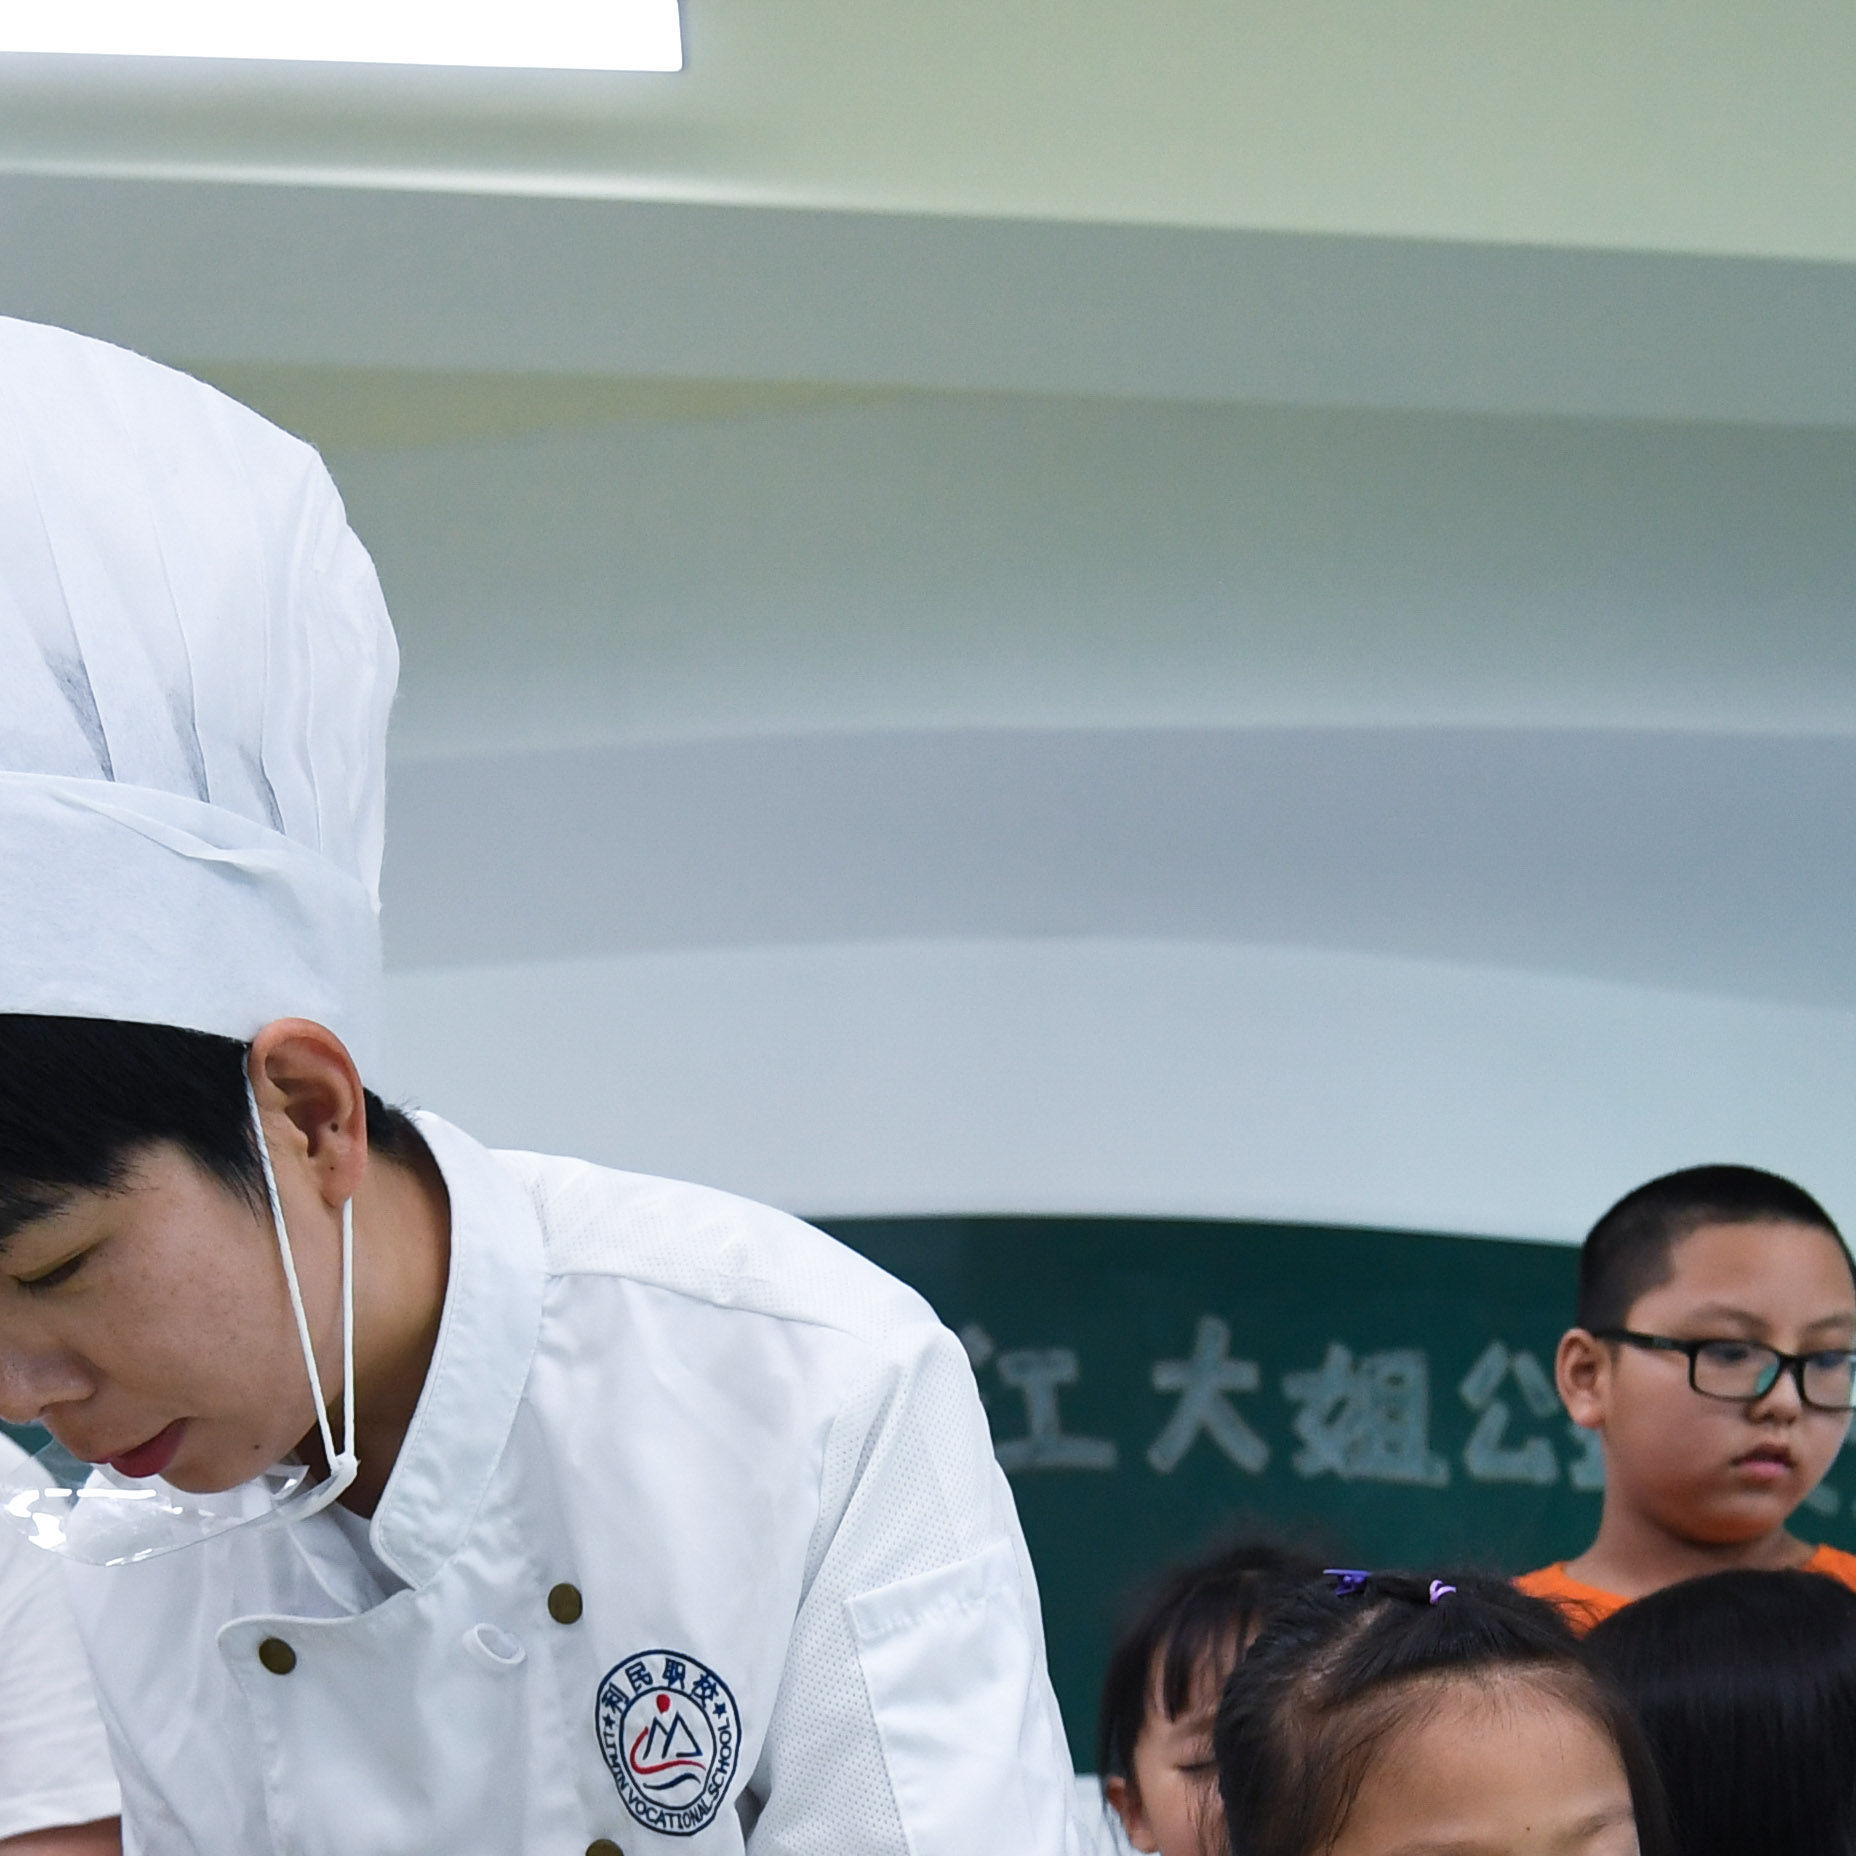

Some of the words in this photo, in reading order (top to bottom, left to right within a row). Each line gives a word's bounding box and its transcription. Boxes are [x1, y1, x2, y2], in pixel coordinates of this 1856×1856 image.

[601, 1657, 719, 1714] 利民职校
[628, 1789, 715, 1830] VOCATIONAL
[708, 1716, 732, 1800] SCHOOL
